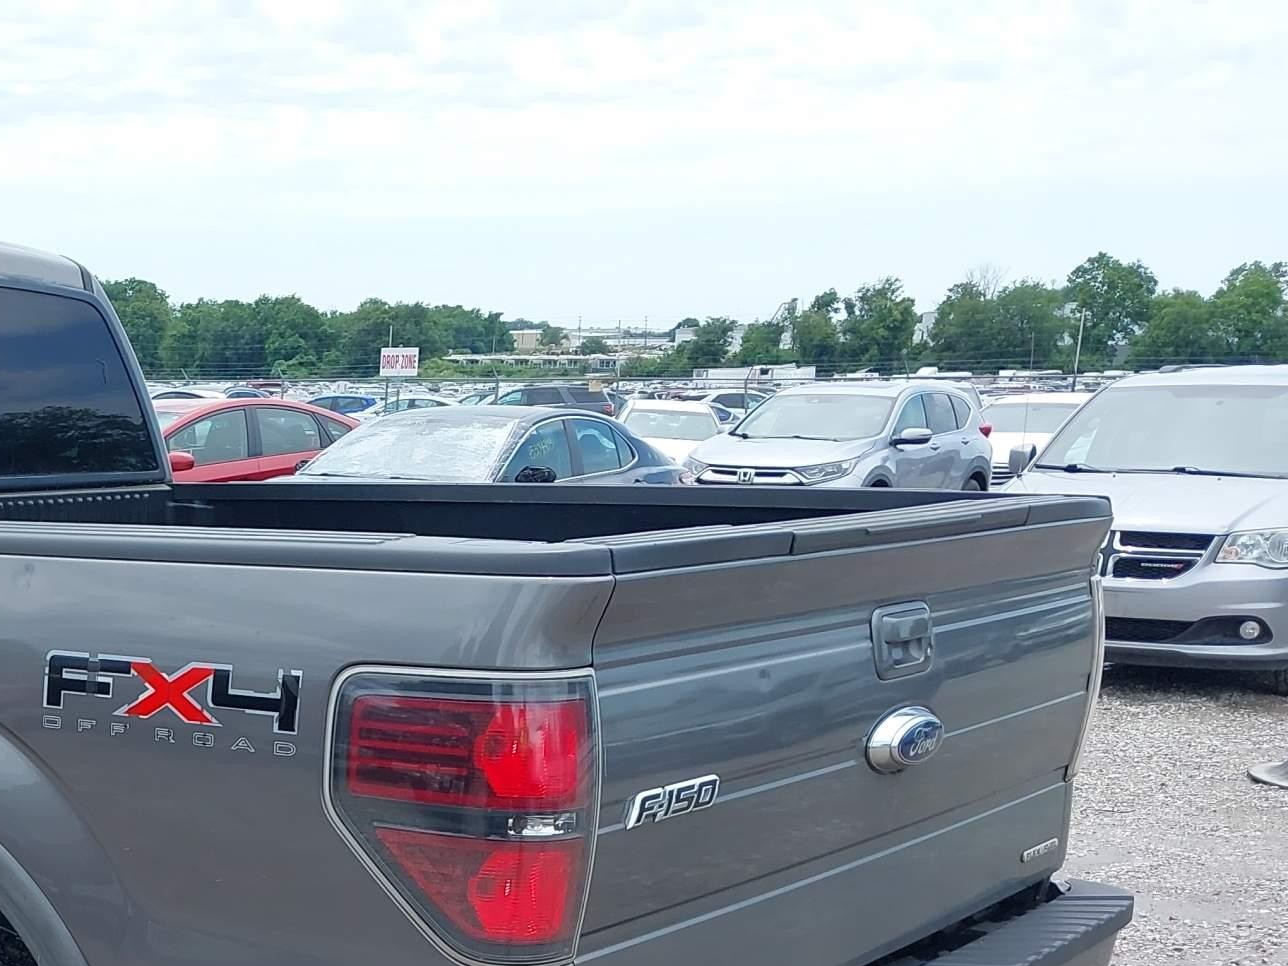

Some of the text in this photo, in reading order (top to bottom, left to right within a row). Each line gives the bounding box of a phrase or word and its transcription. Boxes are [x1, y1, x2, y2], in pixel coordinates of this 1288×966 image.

[382, 354, 416, 370] DROP ZONE
[43, 650, 303, 734] FX4
[154, 728, 297, 757] ROAD
[909, 726, 940, 757] Ford
